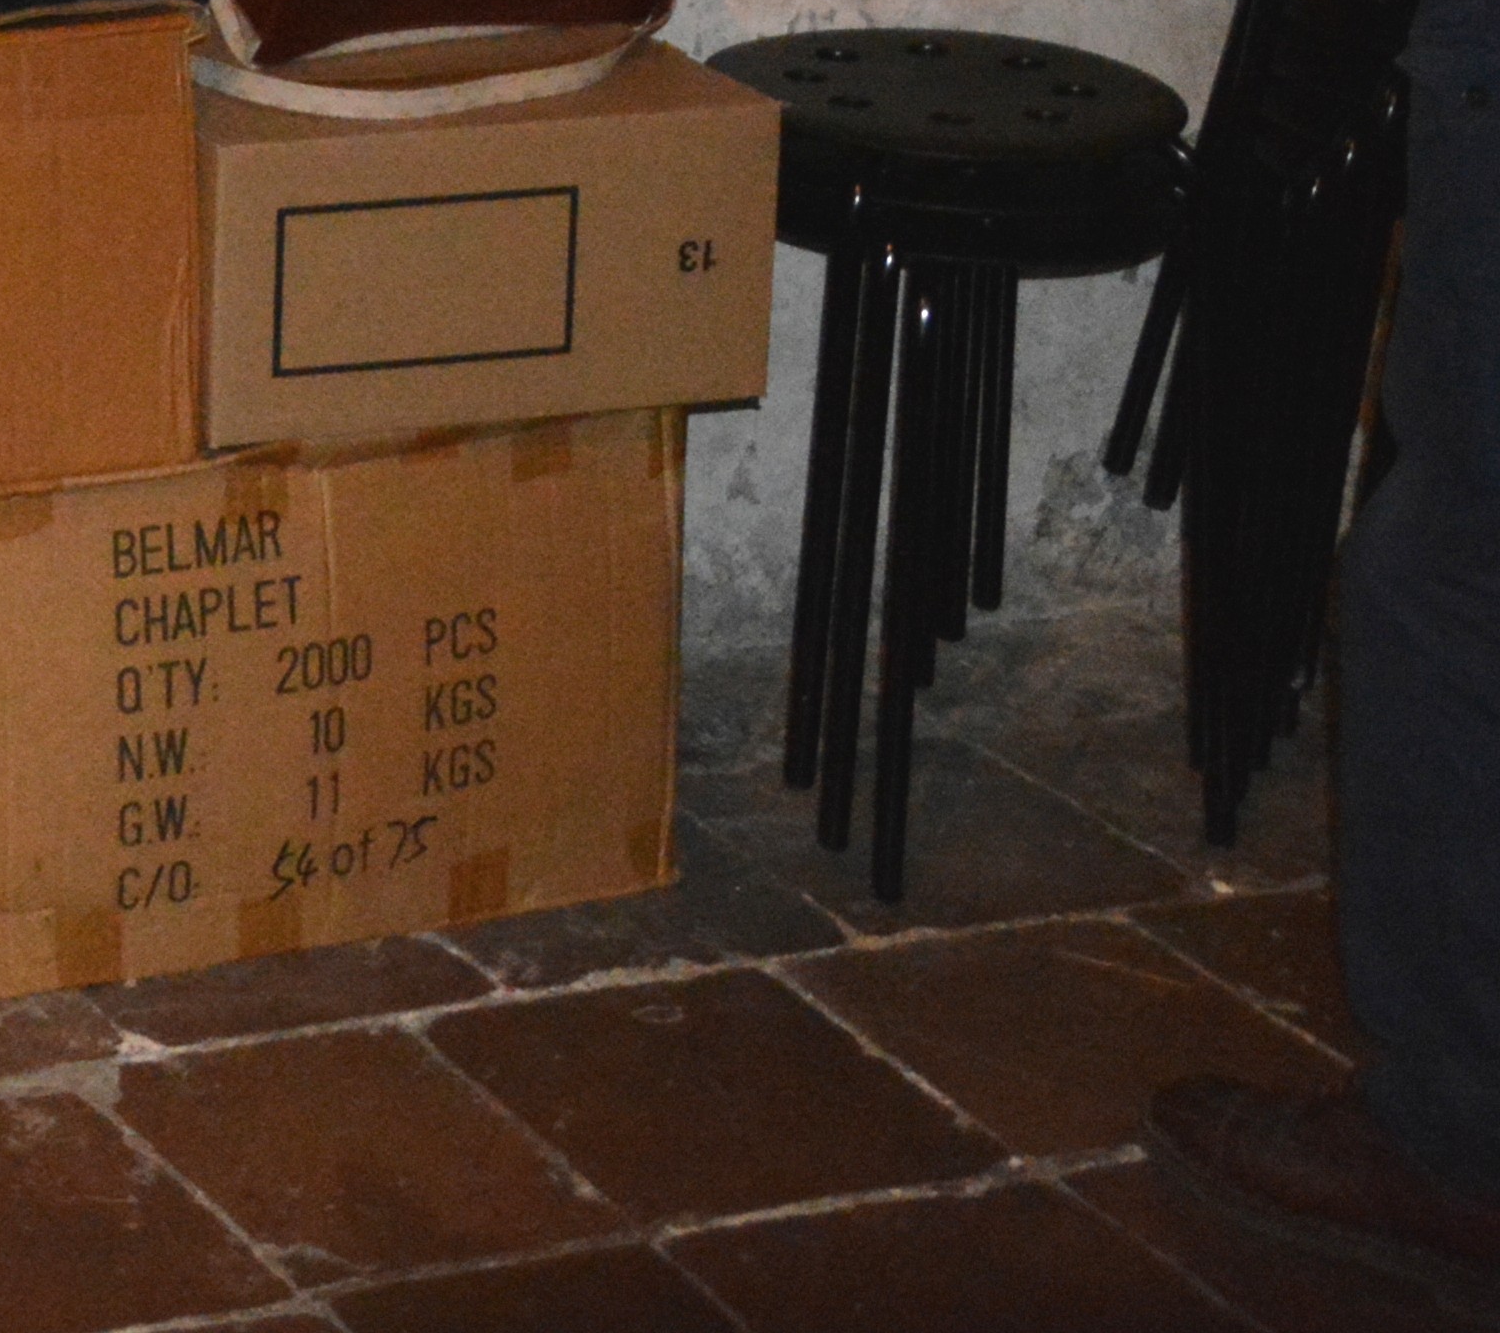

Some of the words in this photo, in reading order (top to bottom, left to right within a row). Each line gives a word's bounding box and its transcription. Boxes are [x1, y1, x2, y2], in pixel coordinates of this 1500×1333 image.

[678, 239, 717, 273] 13
[111, 509, 283, 580] BELMAR
[114, 574, 303, 647] CHAPLET
[275, 632, 373, 696] 2000
[424, 607, 498, 667] PCS
[309, 705, 346, 756] 10
[423, 673, 498, 733] KGS
[305, 770, 341, 822] 11
[421, 738, 496, 797] KGS
[330, 826, 376, 878] of
[385, 813, 439, 871] 75
